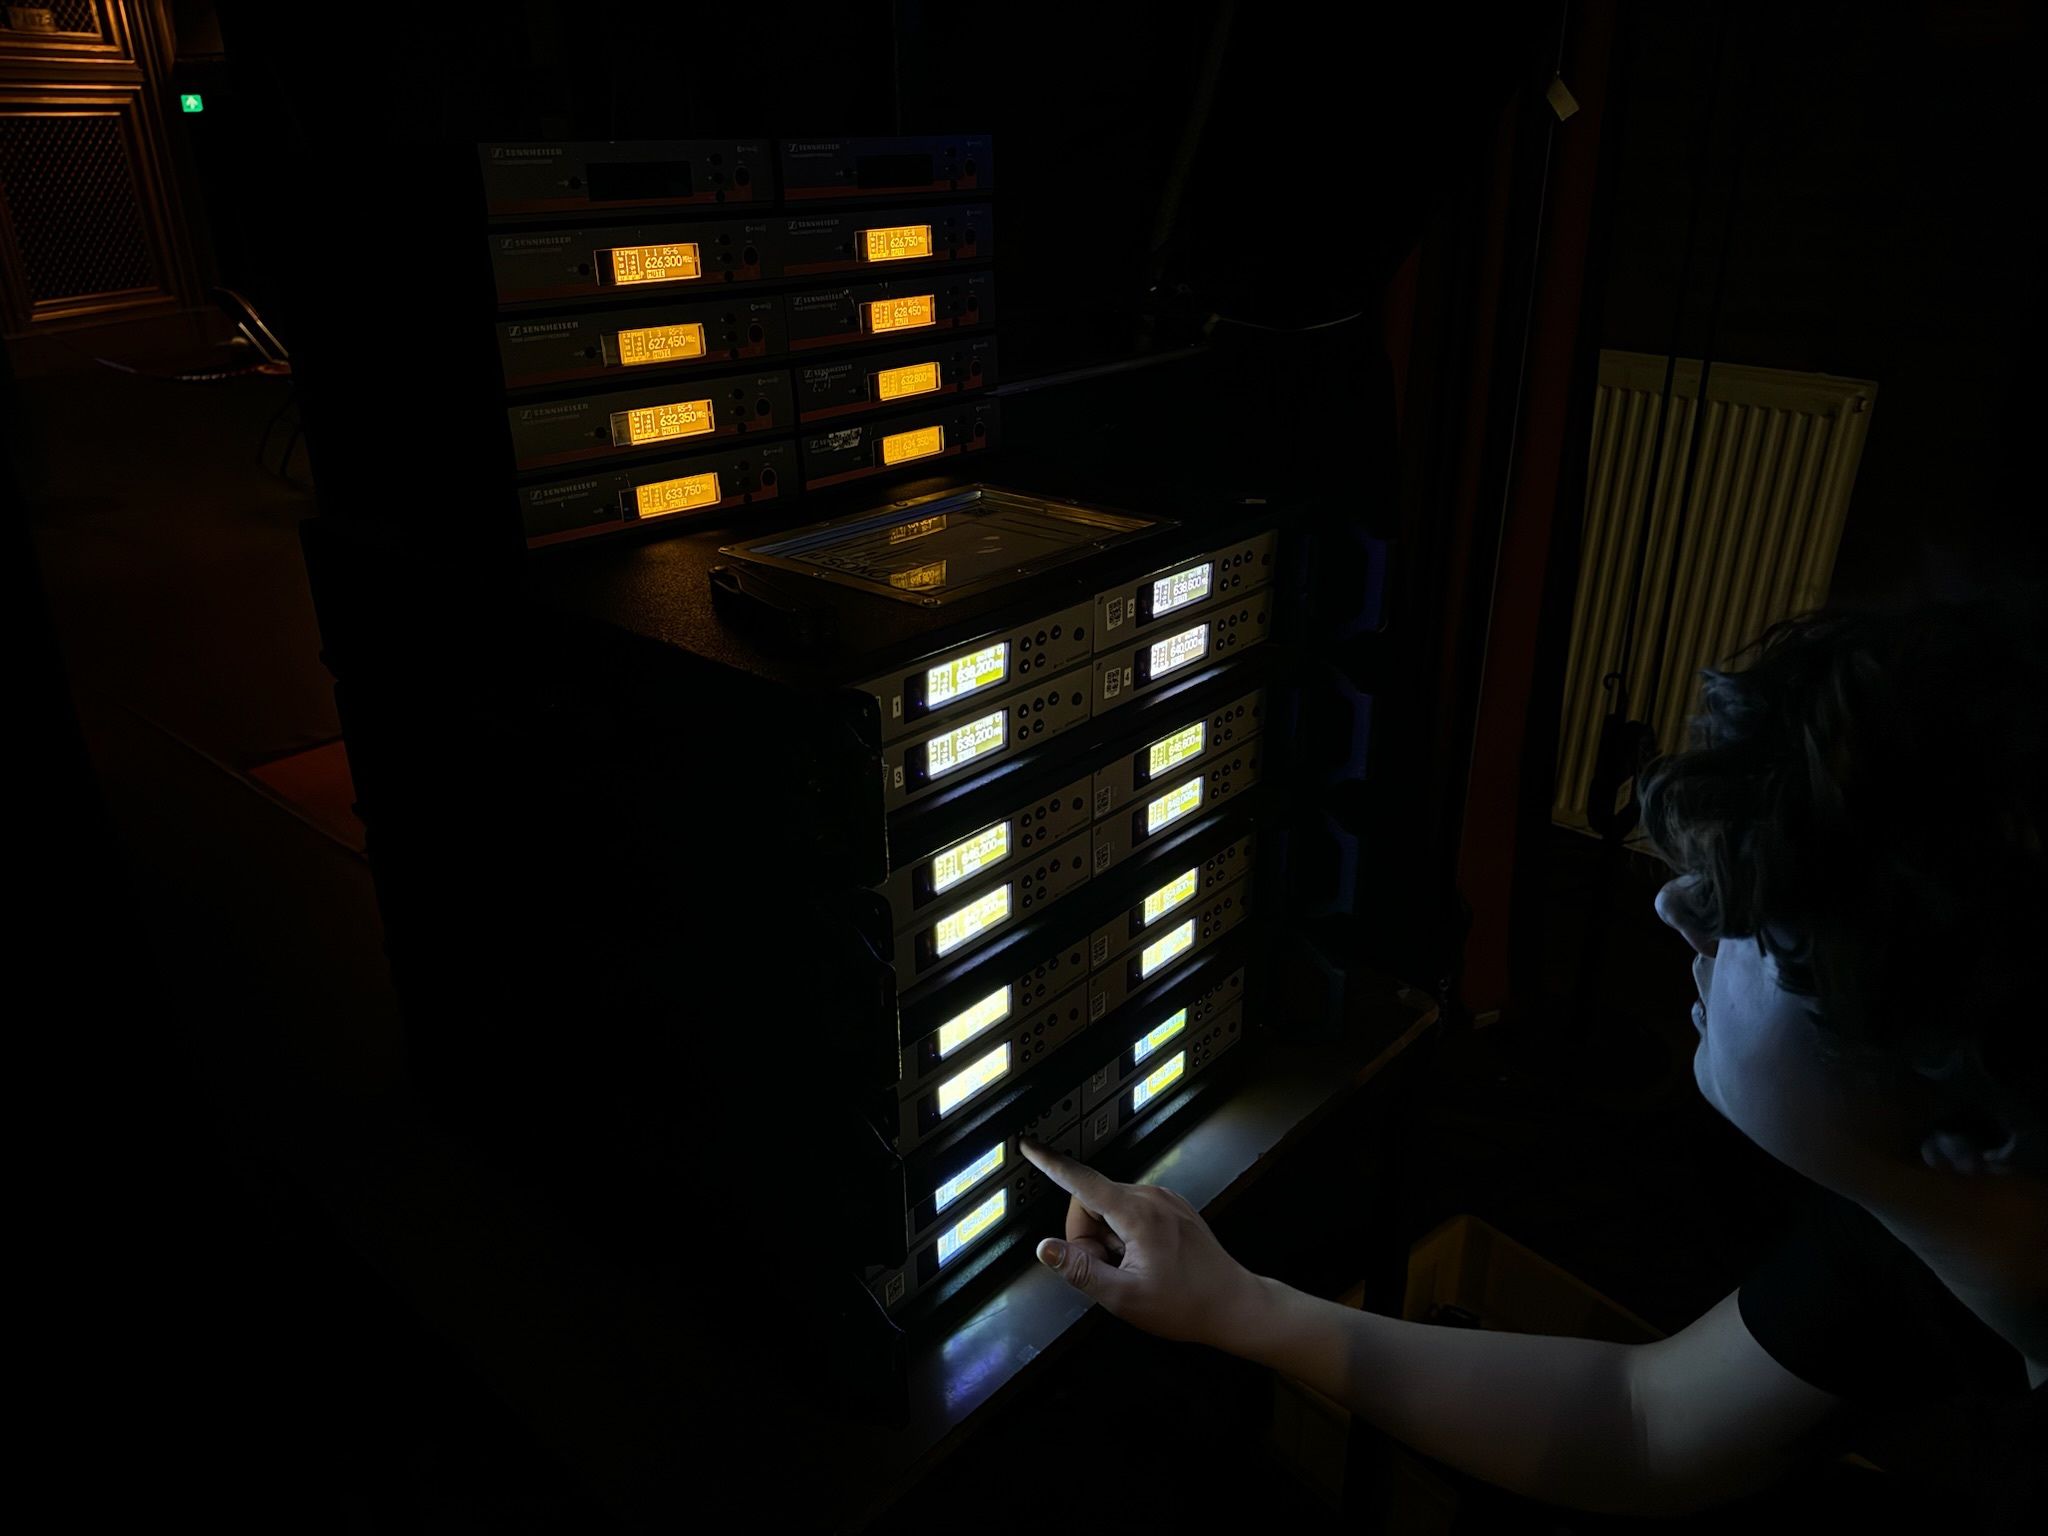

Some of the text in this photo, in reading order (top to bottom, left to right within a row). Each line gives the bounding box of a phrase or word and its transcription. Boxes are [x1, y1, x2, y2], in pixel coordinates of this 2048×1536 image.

[890, 236, 918, 248] 626.750
[645, 255, 683, 269] 626.300
[647, 269, 666, 280] MUTE
[648, 335, 686, 350] 627.450
[660, 411, 697, 427] 632.350
[665, 484, 702, 501] 633.750
[1173, 576, 1202, 597] 638.600
[1170, 636, 1198, 658] 640.000
[895, 771, 902, 784] 3
